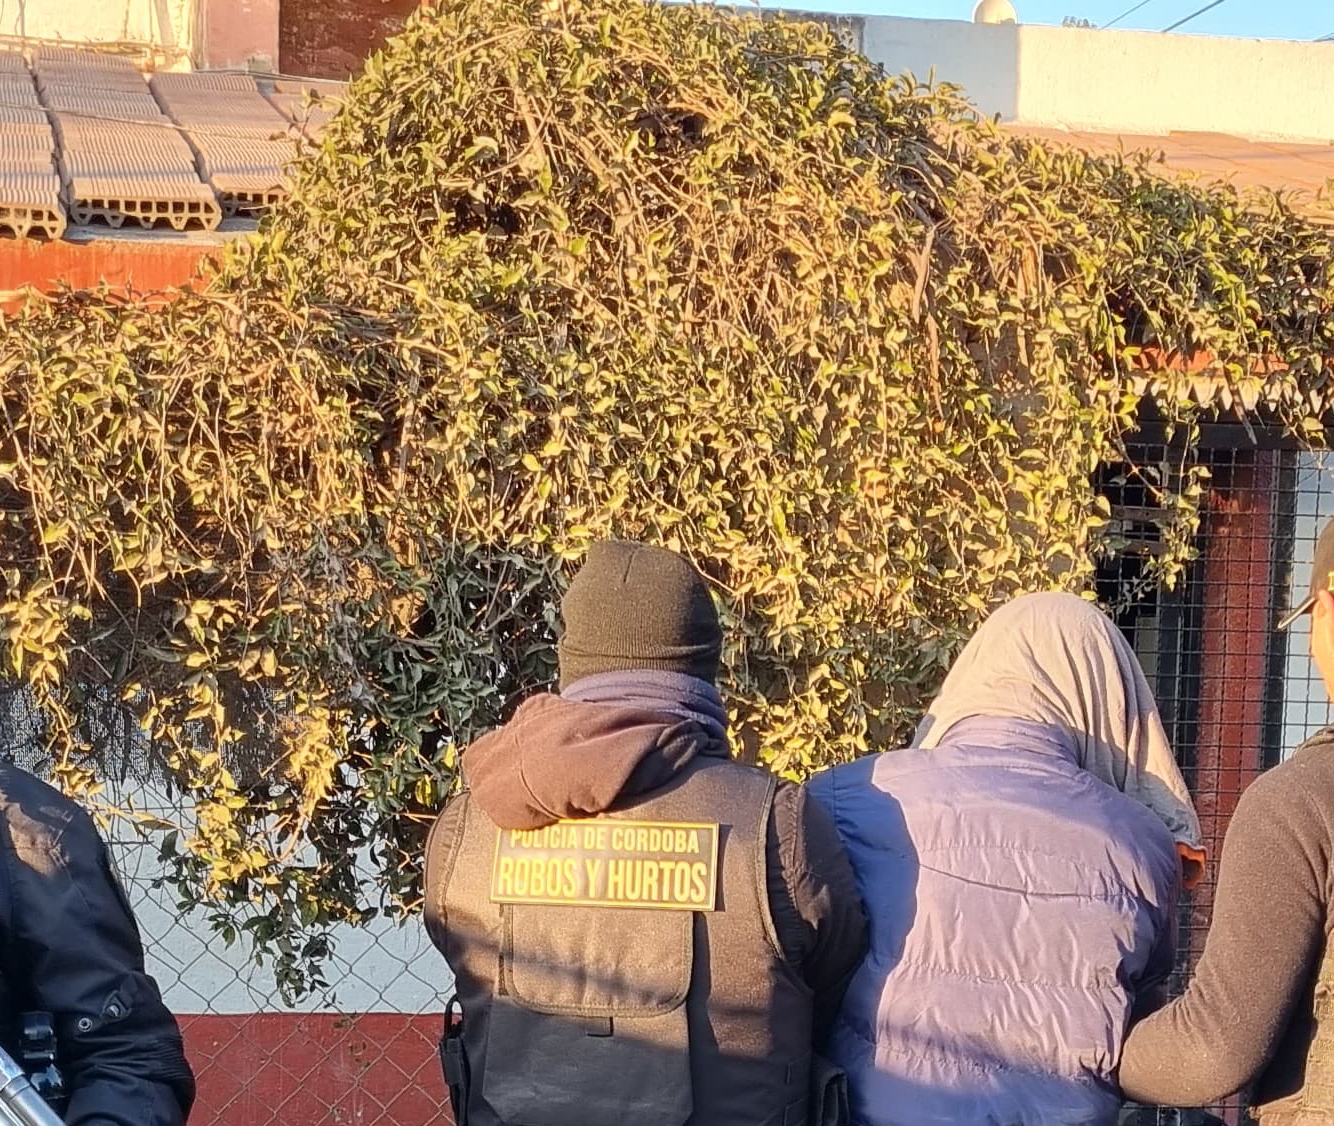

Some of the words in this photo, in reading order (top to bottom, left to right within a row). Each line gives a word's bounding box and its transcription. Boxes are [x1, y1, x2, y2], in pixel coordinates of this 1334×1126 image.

[510, 826, 578, 849] POLICIA
[584, 827, 606, 850] DE
[611, 828, 700, 854] CORDOBA
[498, 857, 577, 898] ROBOS
[585, 859, 601, 898] Y
[607, 860, 708, 903] HURTOS
